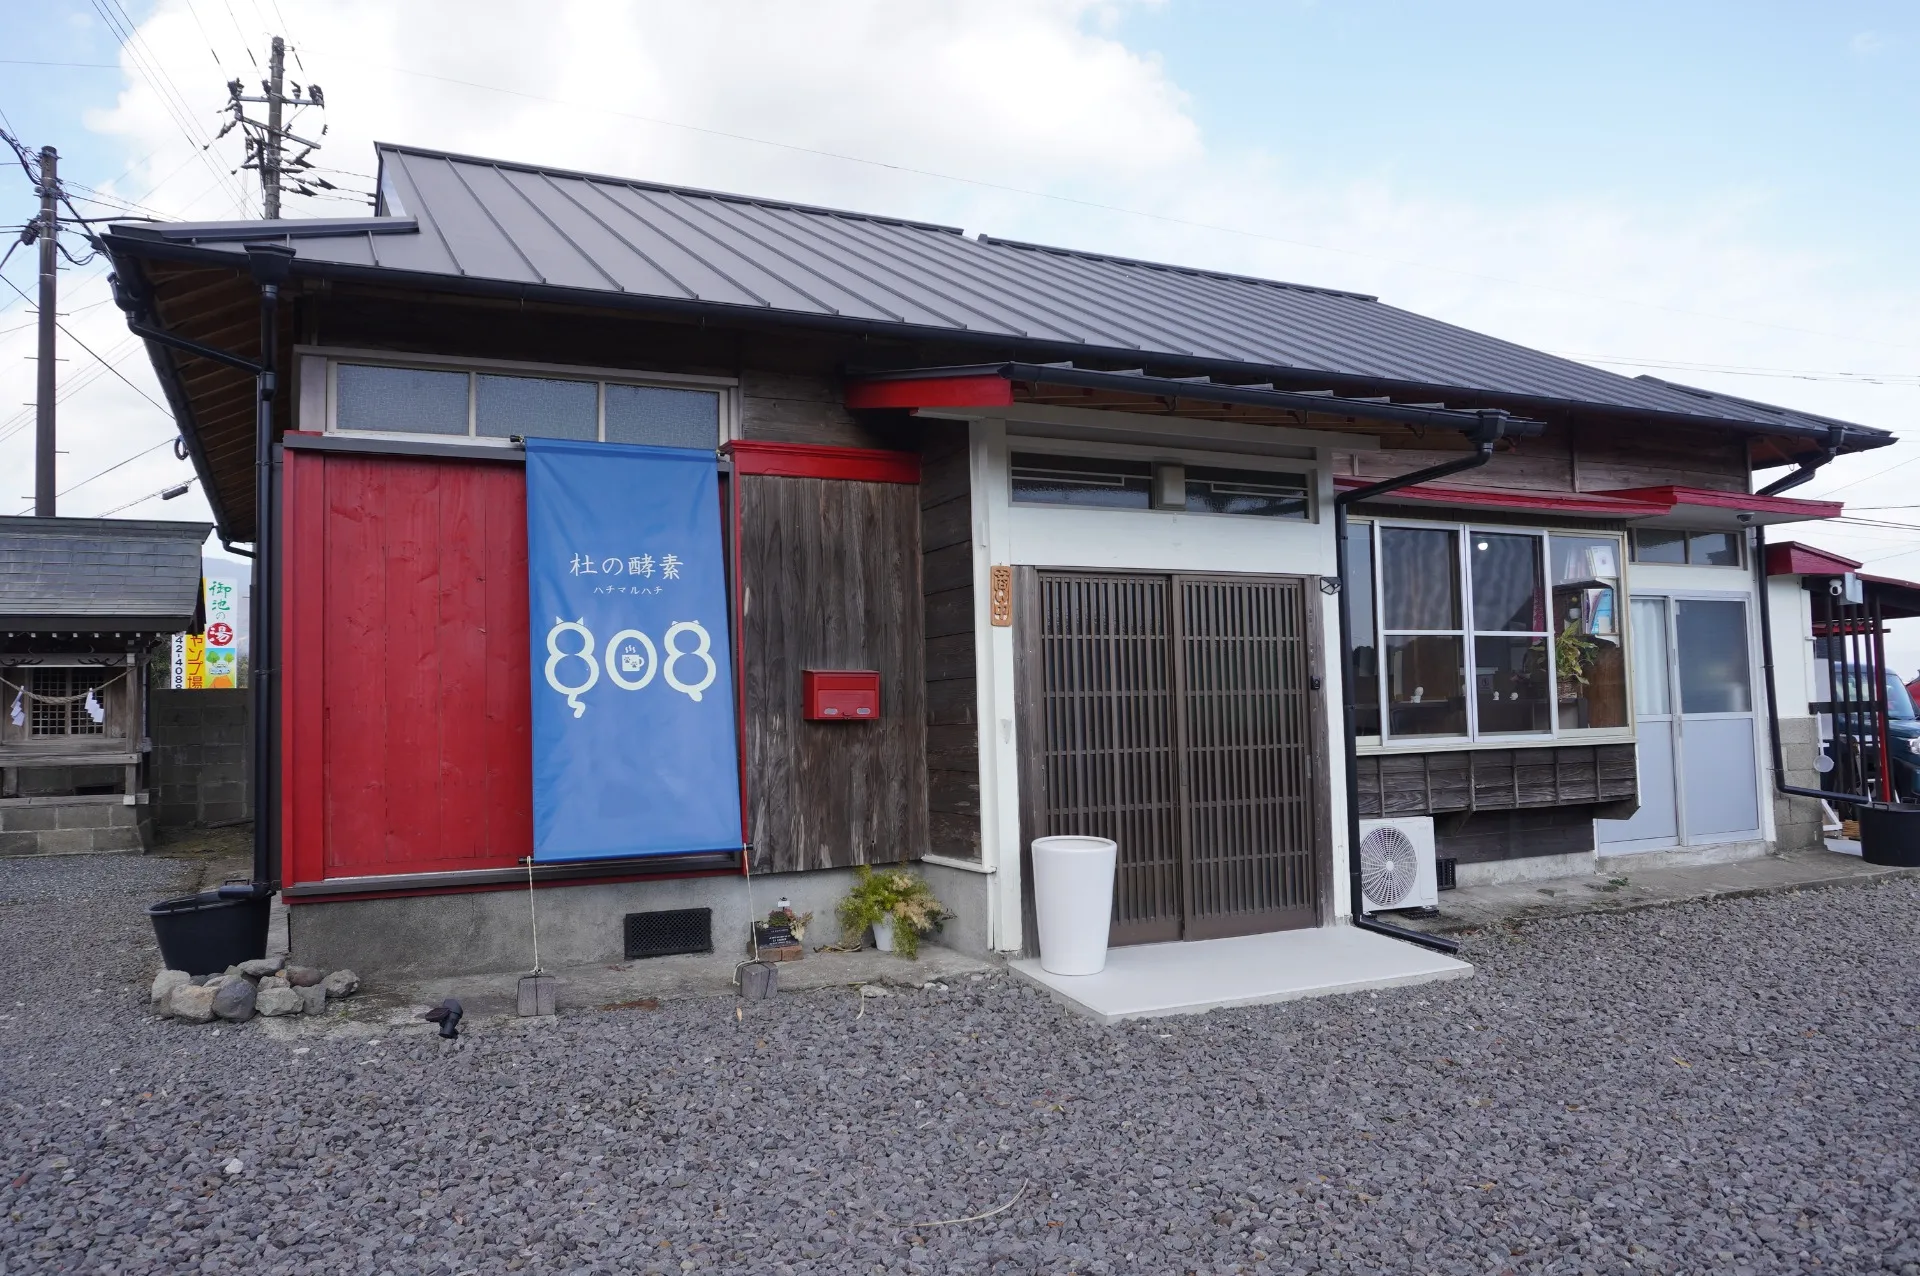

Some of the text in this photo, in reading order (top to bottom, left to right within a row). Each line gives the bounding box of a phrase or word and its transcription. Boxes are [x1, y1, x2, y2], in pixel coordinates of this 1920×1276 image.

[570, 552, 683, 580] 杜の酵素
[209, 581, 234, 644] 御池の湯
[593, 585, 664, 595] ハチマルハチ
[545, 616, 716, 718] 808
